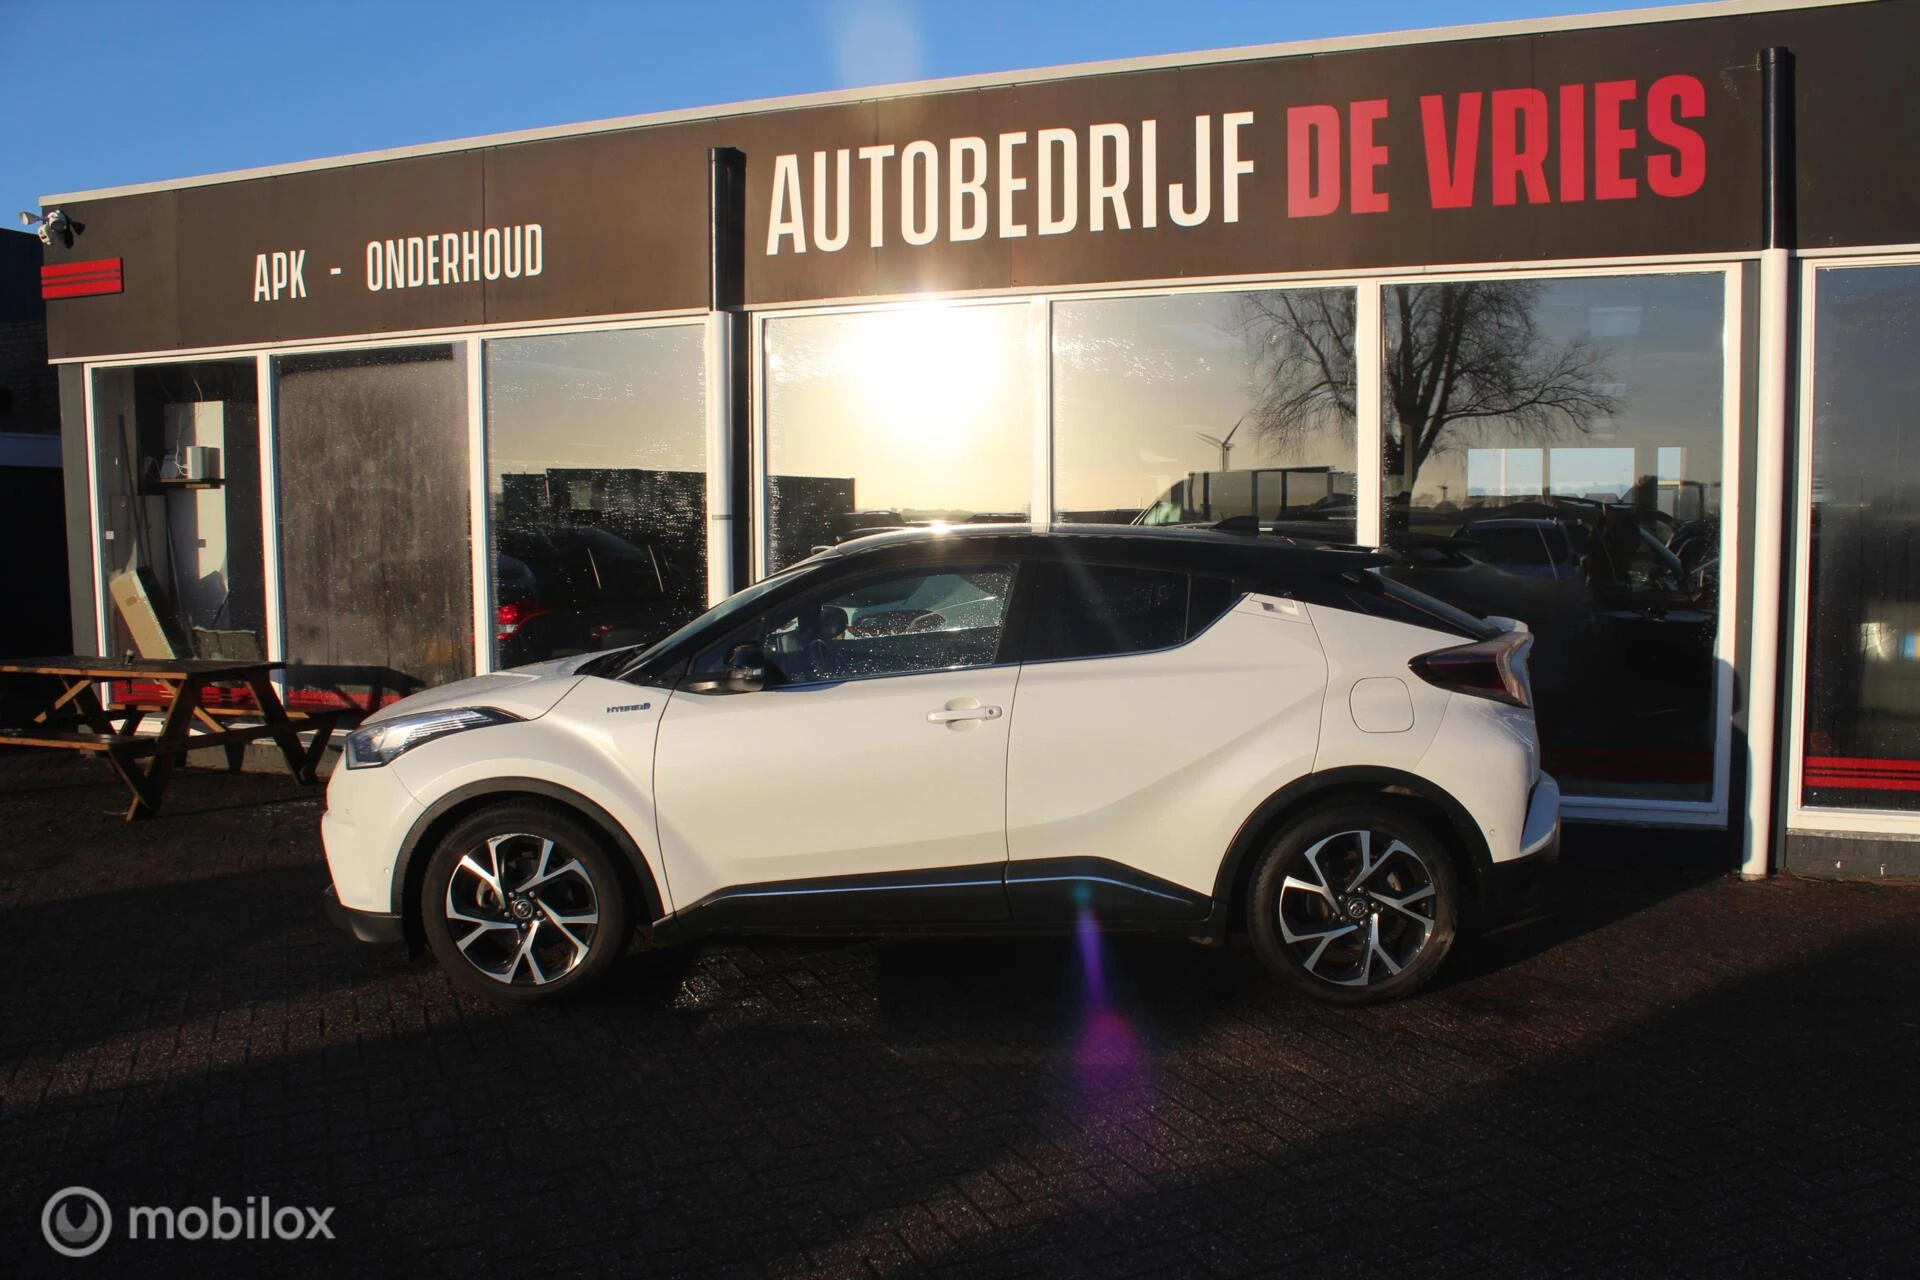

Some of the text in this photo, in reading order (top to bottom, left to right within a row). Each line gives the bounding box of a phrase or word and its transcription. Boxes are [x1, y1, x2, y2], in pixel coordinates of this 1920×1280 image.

[766, 74, 1706, 256] AUTOBEDRIJF DE VRIES
[253, 249, 308, 303] APK
[366, 223, 543, 292] ONDERHOUD
